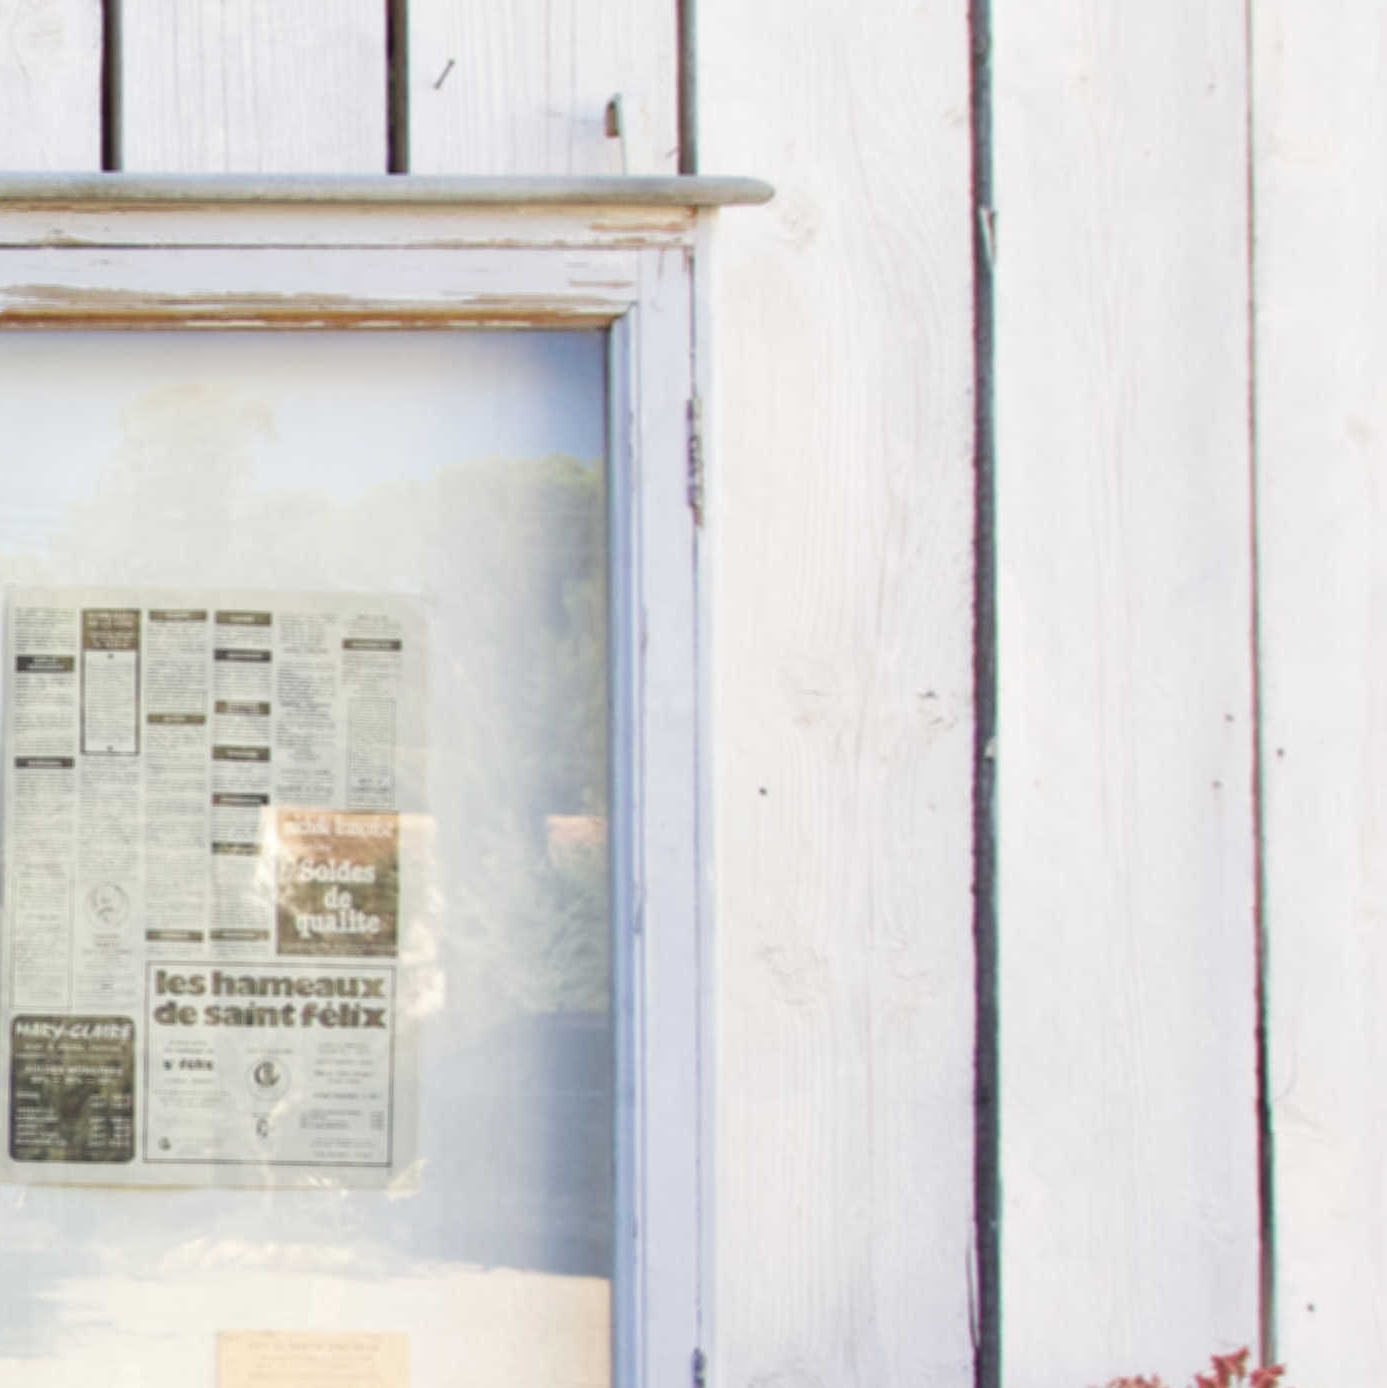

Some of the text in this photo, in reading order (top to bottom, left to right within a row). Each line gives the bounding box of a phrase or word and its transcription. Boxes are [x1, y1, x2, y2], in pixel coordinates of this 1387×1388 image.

[297, 858, 375, 884] Soldes
[324, 885, 352, 910] de
[154, 970, 386, 999] les hameaux
[153, 1001, 198, 1026] de
[204, 1001, 295, 1028] saint
